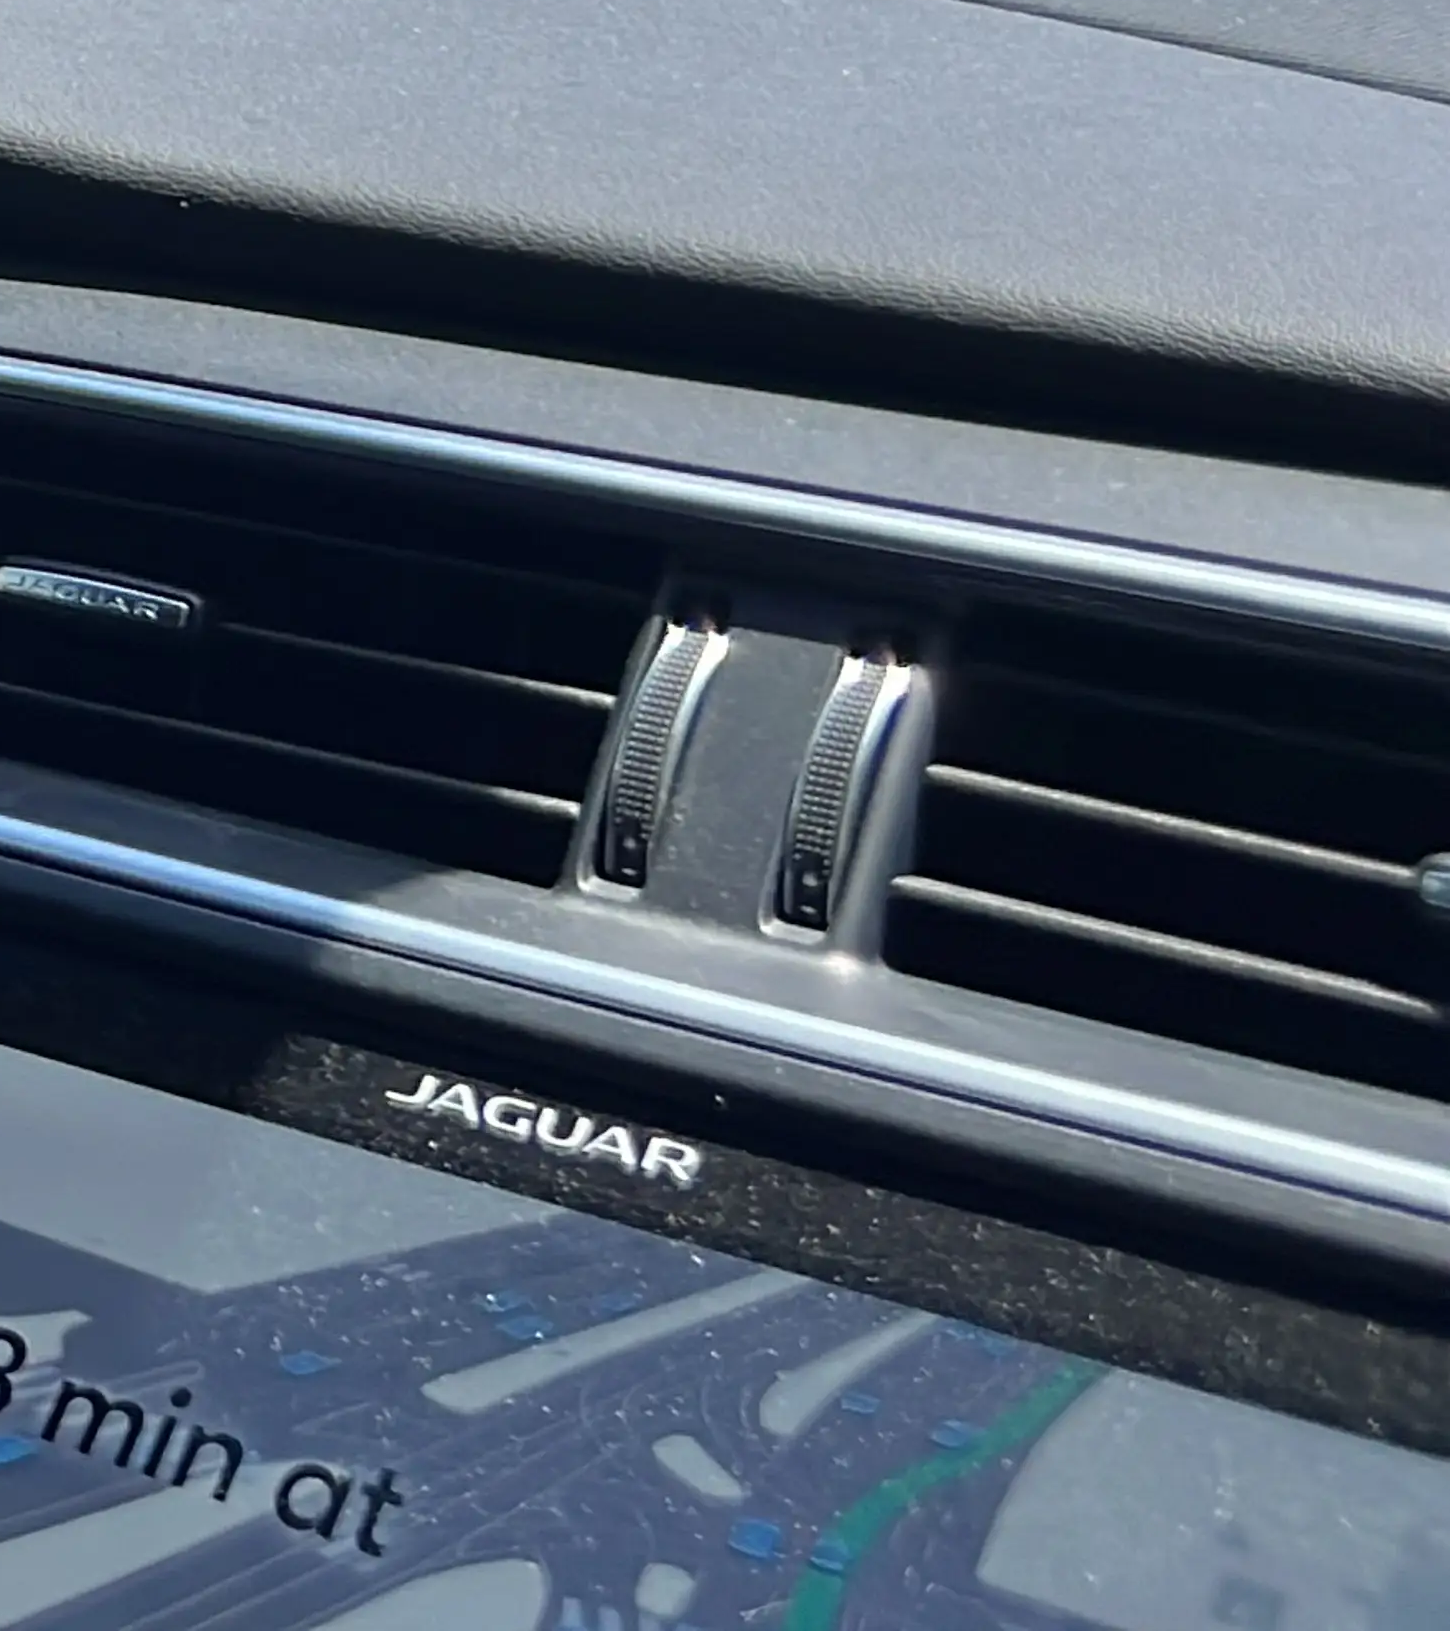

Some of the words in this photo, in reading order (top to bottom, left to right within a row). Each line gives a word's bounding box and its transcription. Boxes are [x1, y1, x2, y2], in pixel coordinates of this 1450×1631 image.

[5, 575, 160, 623] JAGUAR
[384, 1073, 703, 1185] JAGUAR
[39, 1378, 245, 1503] min
[274, 1460, 405, 1558] at
